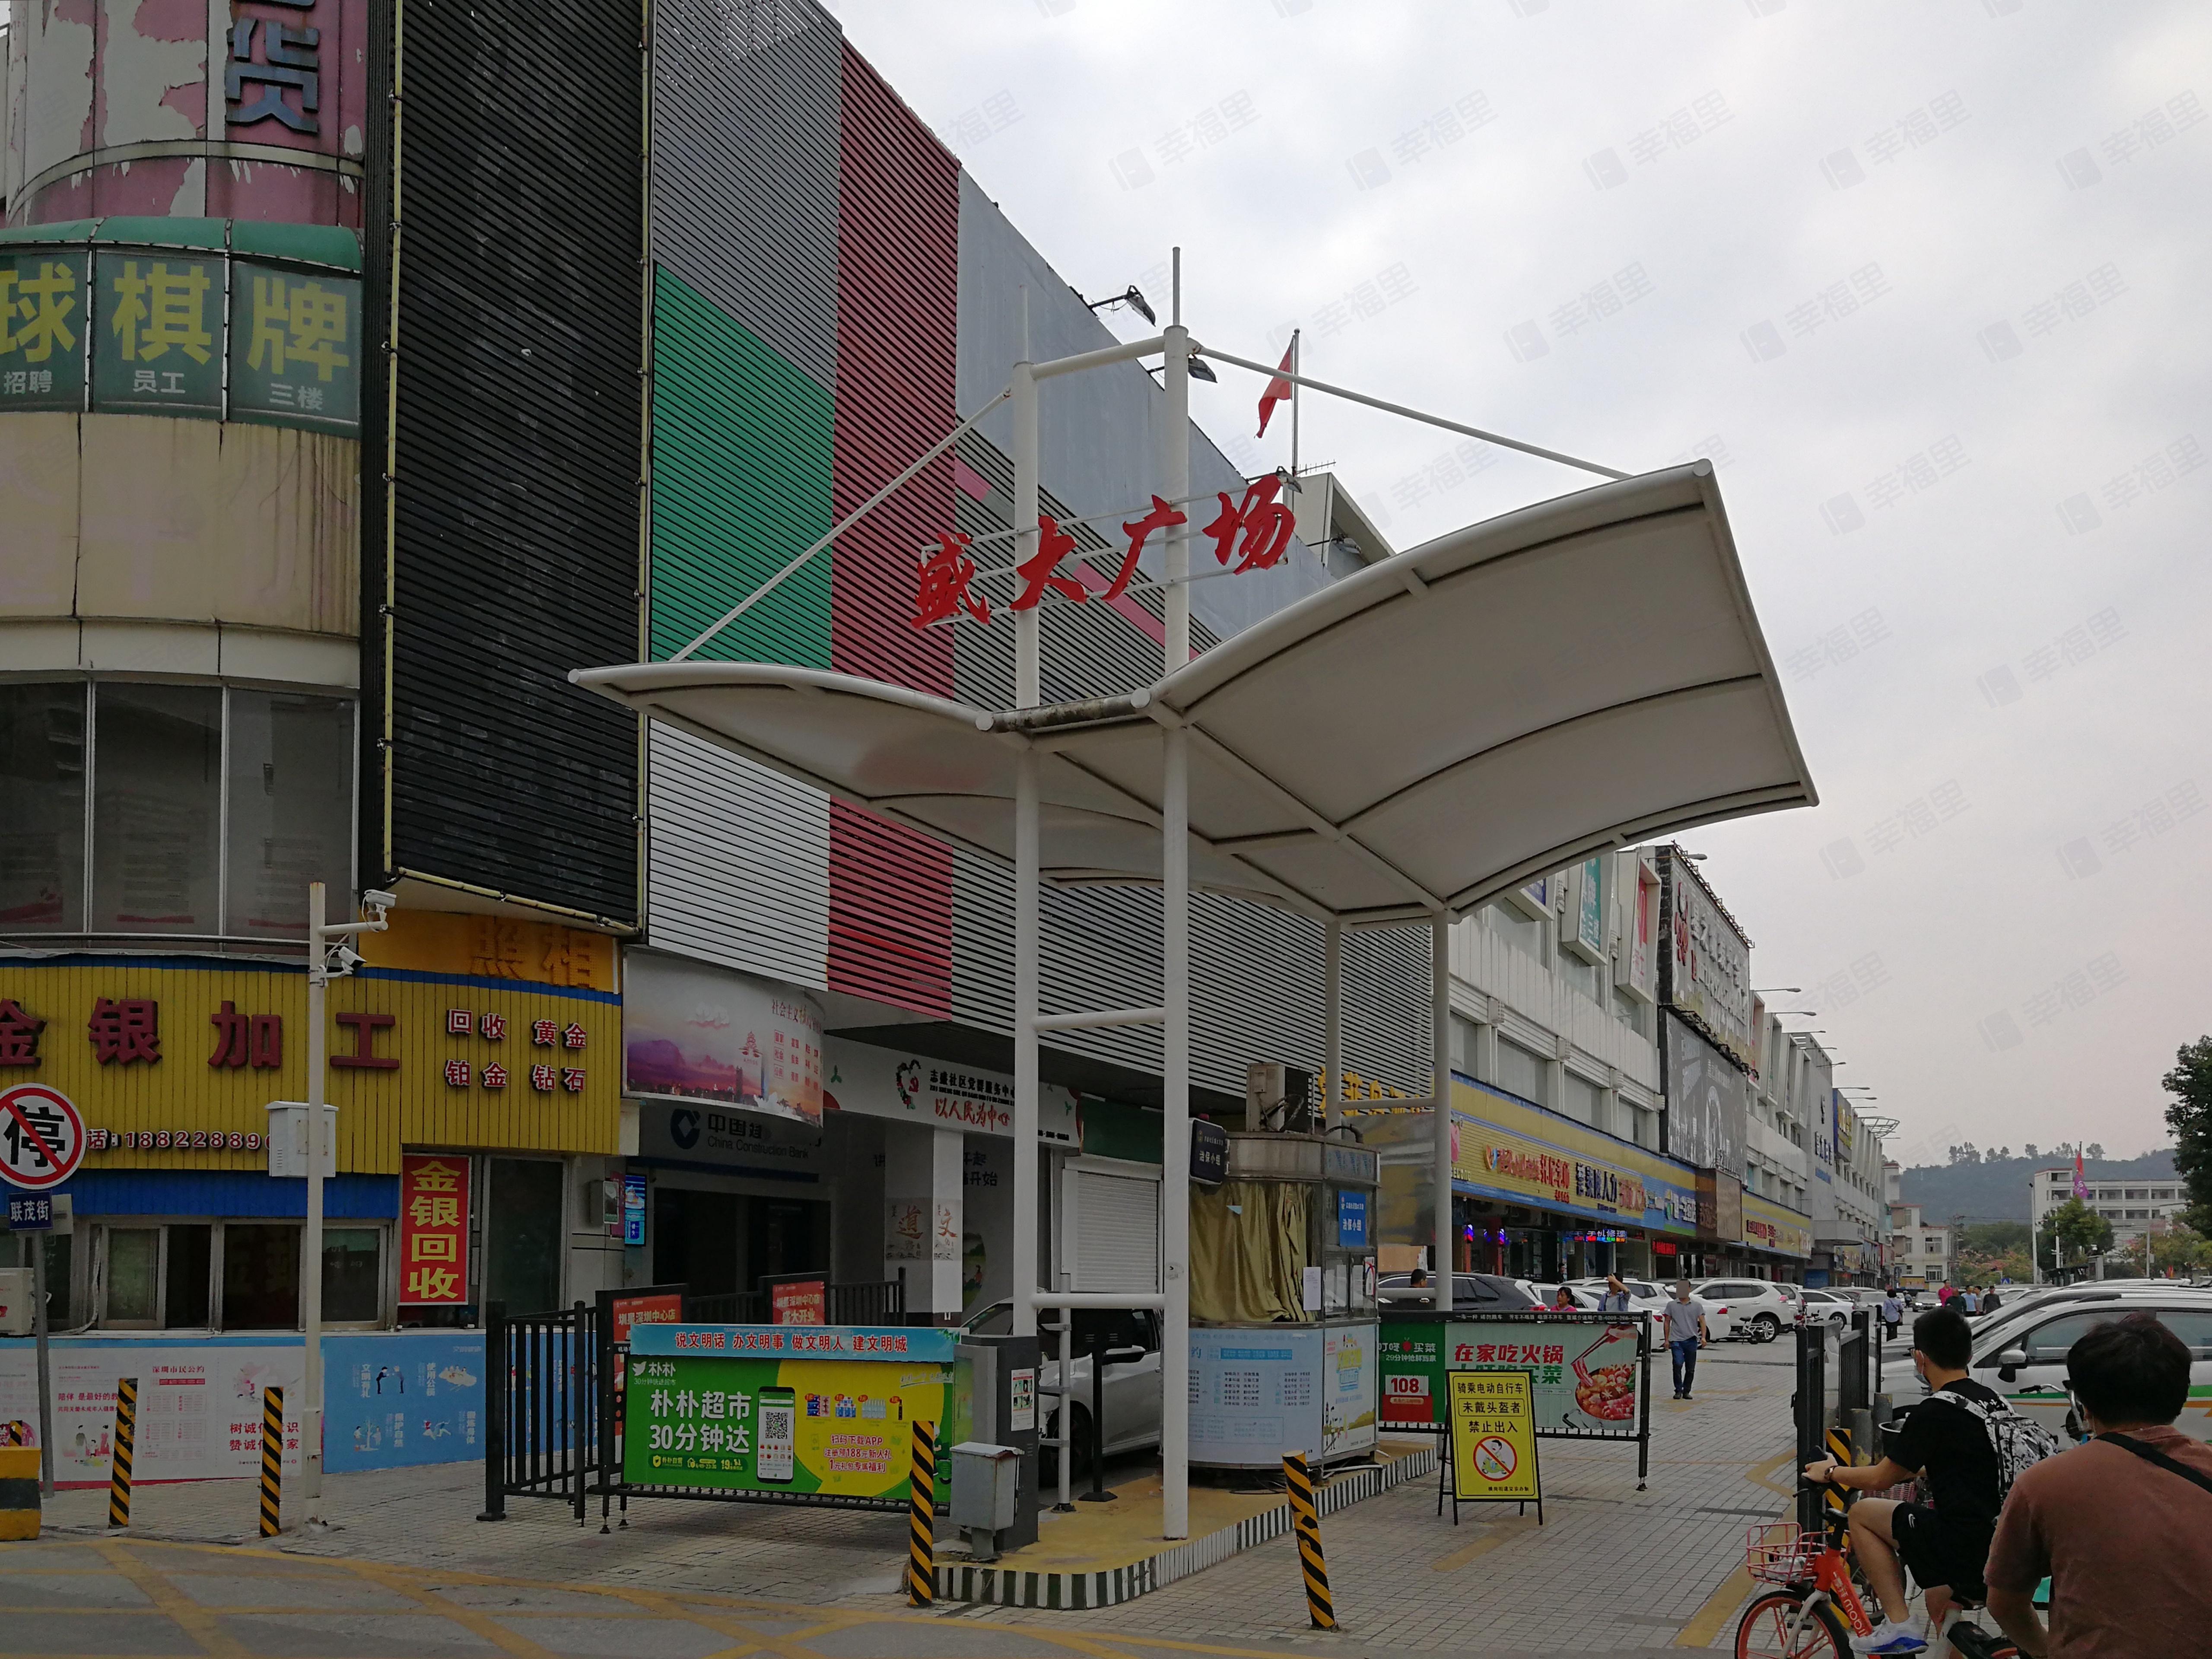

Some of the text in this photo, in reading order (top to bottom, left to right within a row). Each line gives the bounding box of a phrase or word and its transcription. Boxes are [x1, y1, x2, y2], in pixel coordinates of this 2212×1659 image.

[226, 0, 319, 134] 货
[0, 261, 349, 382] 球棋牌
[3, 369, 53, 395] 招聘
[133, 370, 186, 394] 员工
[269, 383, 323, 411] 三楼
[911, 475, 1295, 629] 盛大广场
[471, 916, 597, 989] 照相
[0, 996, 400, 1069] 金银加工
[448, 1009, 588, 1049] 回收 黄金
[445, 1059, 586, 1091] 铂金 钻石
[935, 1097, 1011, 1131] 以人民为中心
[3, 1104, 66, 1167] 停
[86, 1128, 270, 1150] 话:18822889
[707, 1135, 809, 1159] China Construction Bank
[10, 1200, 49, 1222] 联茂街
[407, 1160, 461, 1300] 金银回收
[675, 1331, 907, 1353] 说文明话 办文明事 做文明人 建文明城
[1455, 1343, 1563, 1364] 在家吃火锅
[153, 1365, 205, 1373] 深圳市民公约
[648, 1361, 676, 1377] 朴朴
[1391, 1378, 1419, 1393] 108
[1457, 1382, 1524, 1394] 骑乘电动自行车
[650, 1389, 752, 1421] 朴朴超市
[1462, 1402, 1521, 1414] 未戴头盔者
[229, 1422, 299, 1434] 树诚识
[648, 1423, 750, 1453] 30分钟达
[1468, 1421, 1518, 1433] 禁止出入
[229, 1439, 299, 1451] 赞诚家
[830, 1433, 884, 1446] 扫码下载APP
[823, 1448, 893, 1461] 注册领188元新人礼
